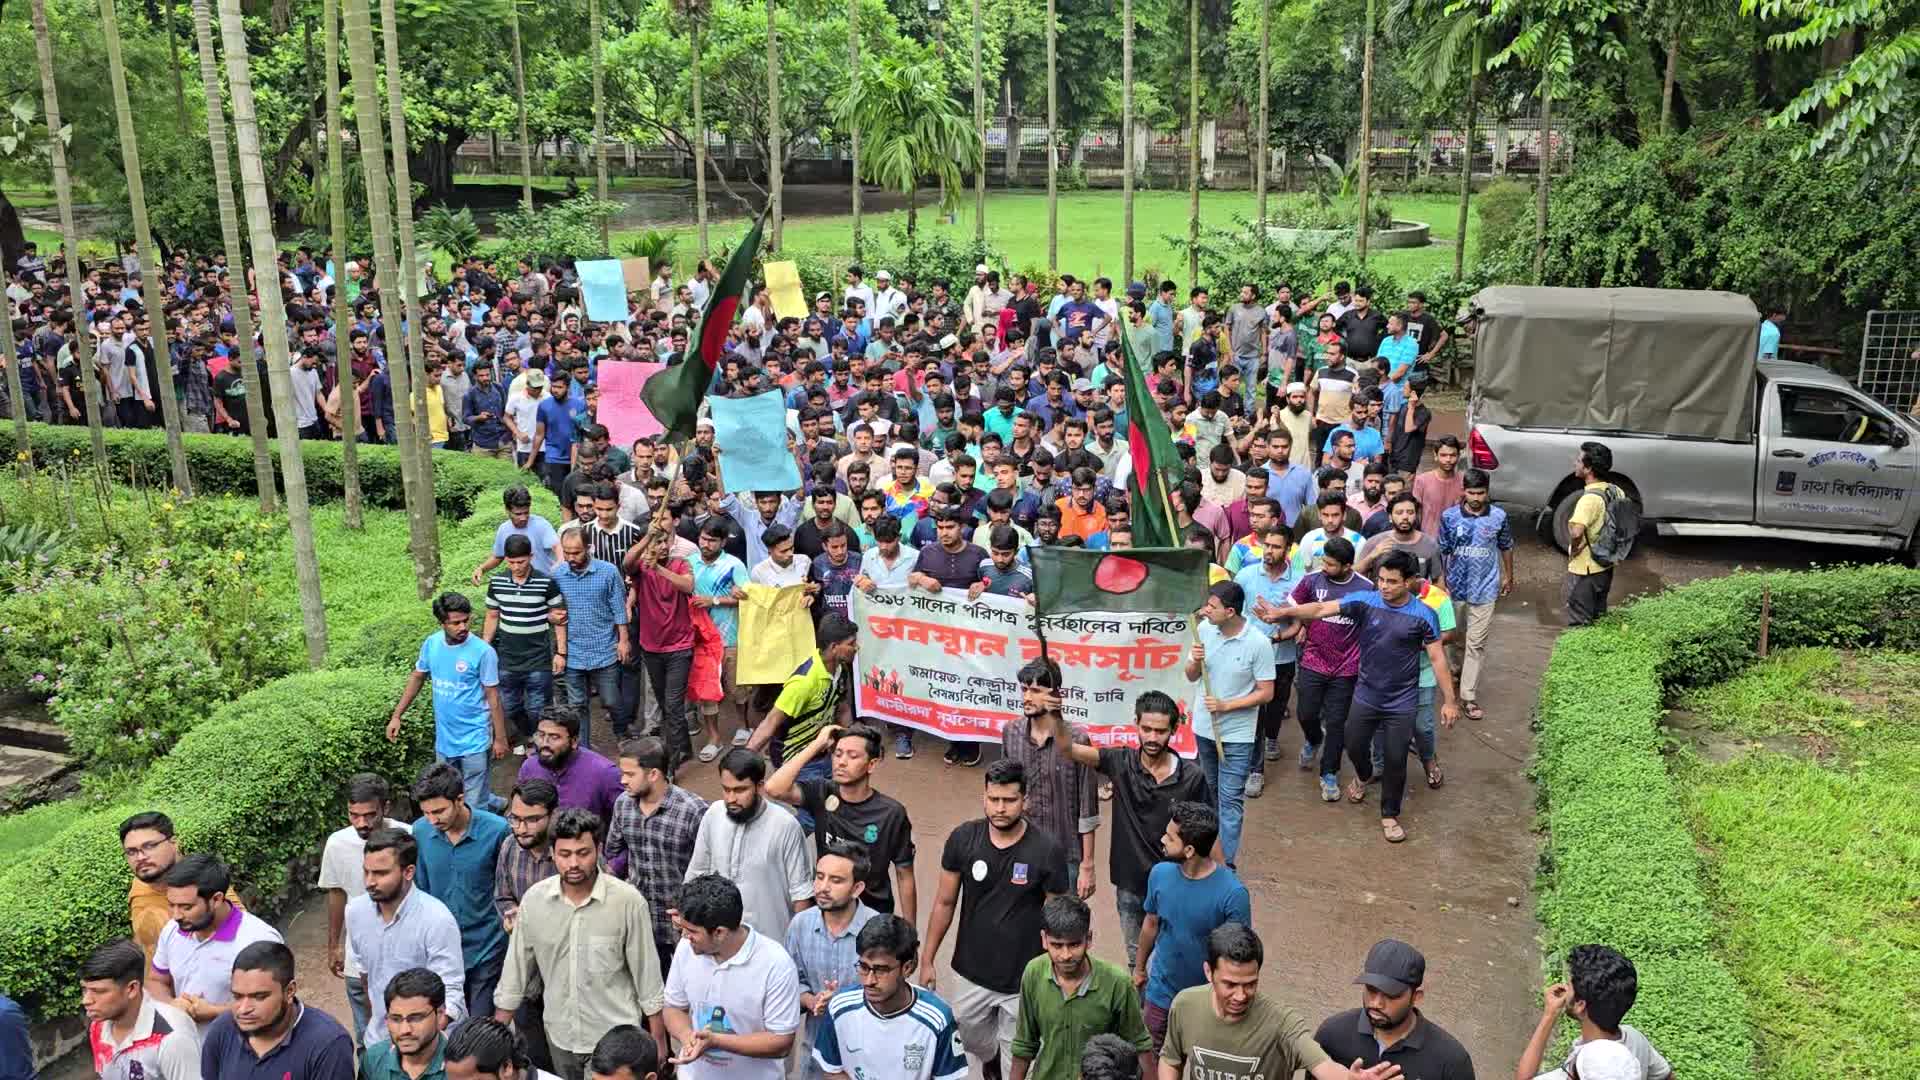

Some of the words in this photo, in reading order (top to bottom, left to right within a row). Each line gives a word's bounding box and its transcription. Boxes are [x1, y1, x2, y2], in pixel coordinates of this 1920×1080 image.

[1801, 480, 1831, 495] ঢাকা
[1832, 478, 1906, 501] বিশ্ববিদ্যালয়
[865, 592, 905, 607] ২০১৮
[910, 595, 958, 614] সালের
[962, 602, 1019, 626] পরিপত্র
[1128, 617, 1188, 634] দাবিতে
[867, 616, 1009, 657] অবস্থান
[908, 664, 961, 685] জমায়েত:
[967, 674, 1017, 694] কেন্দ্রীয়
[1095, 689, 1126, 703] ঢাবি
[929, 682, 1002, 707] বৈষম্যবিরোধী
